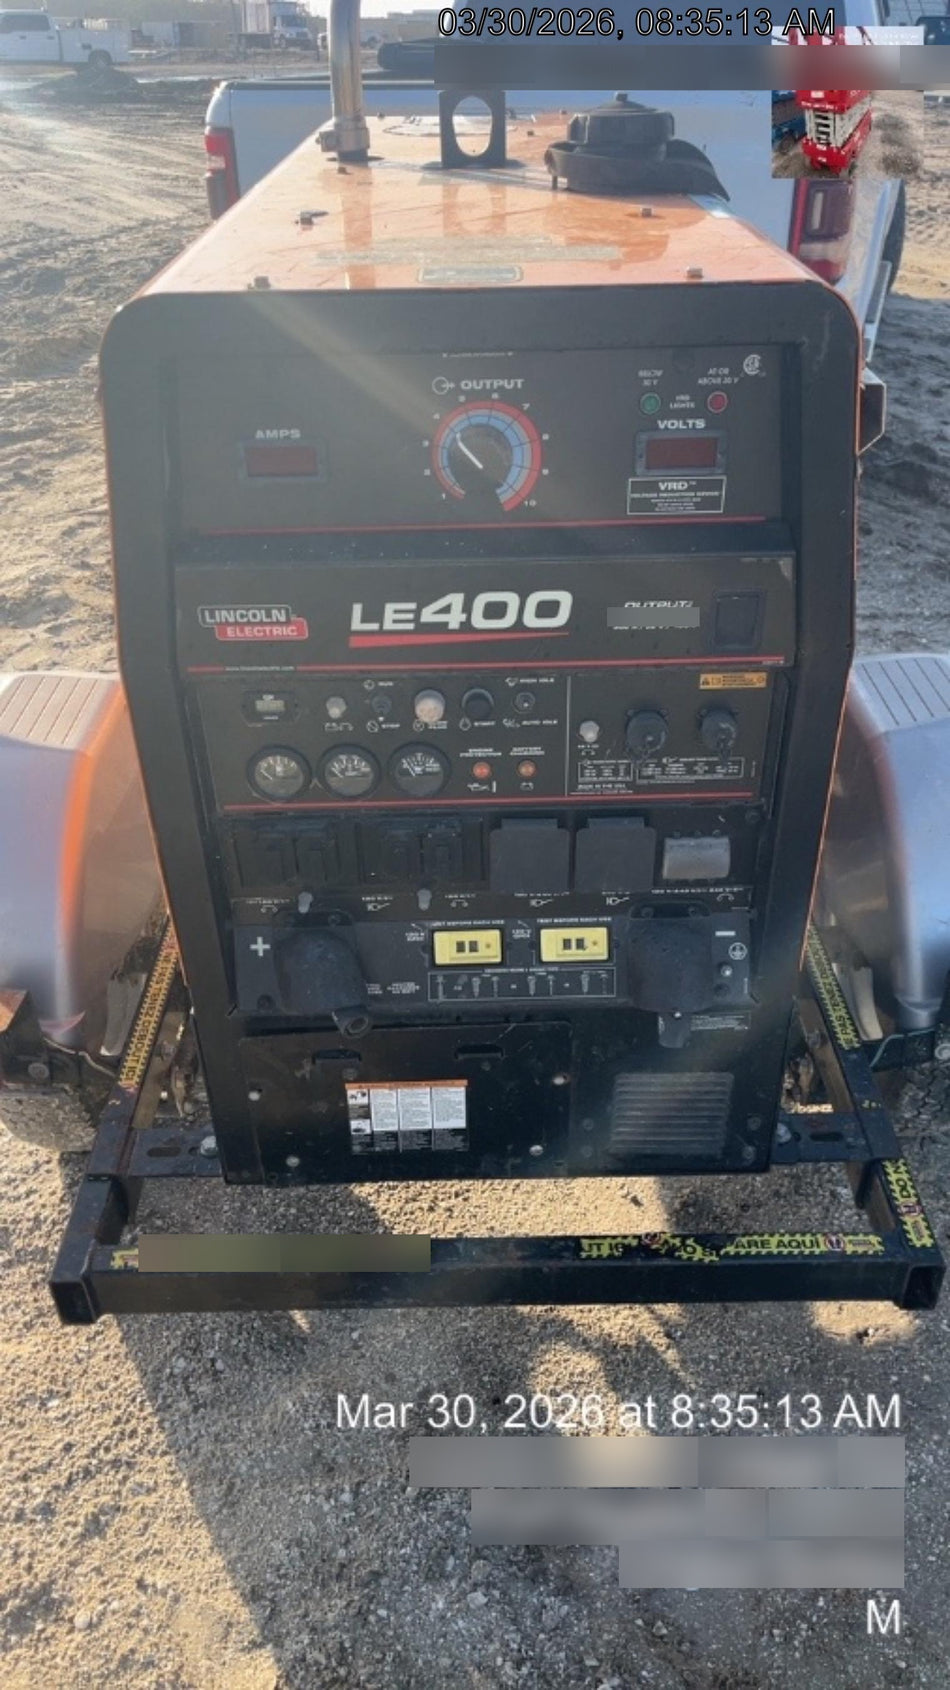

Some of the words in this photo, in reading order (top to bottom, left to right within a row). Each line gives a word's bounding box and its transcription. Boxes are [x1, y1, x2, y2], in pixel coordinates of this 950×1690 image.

[461, 379, 525, 389] OUTPUT
[657, 418, 706, 430] VOLTS
[255, 429, 301, 439] AMPS
[204, 609, 287, 624] LINCOLN
[350, 590, 574, 631] LE400
[226, 626, 298, 638] ELECTRIC
